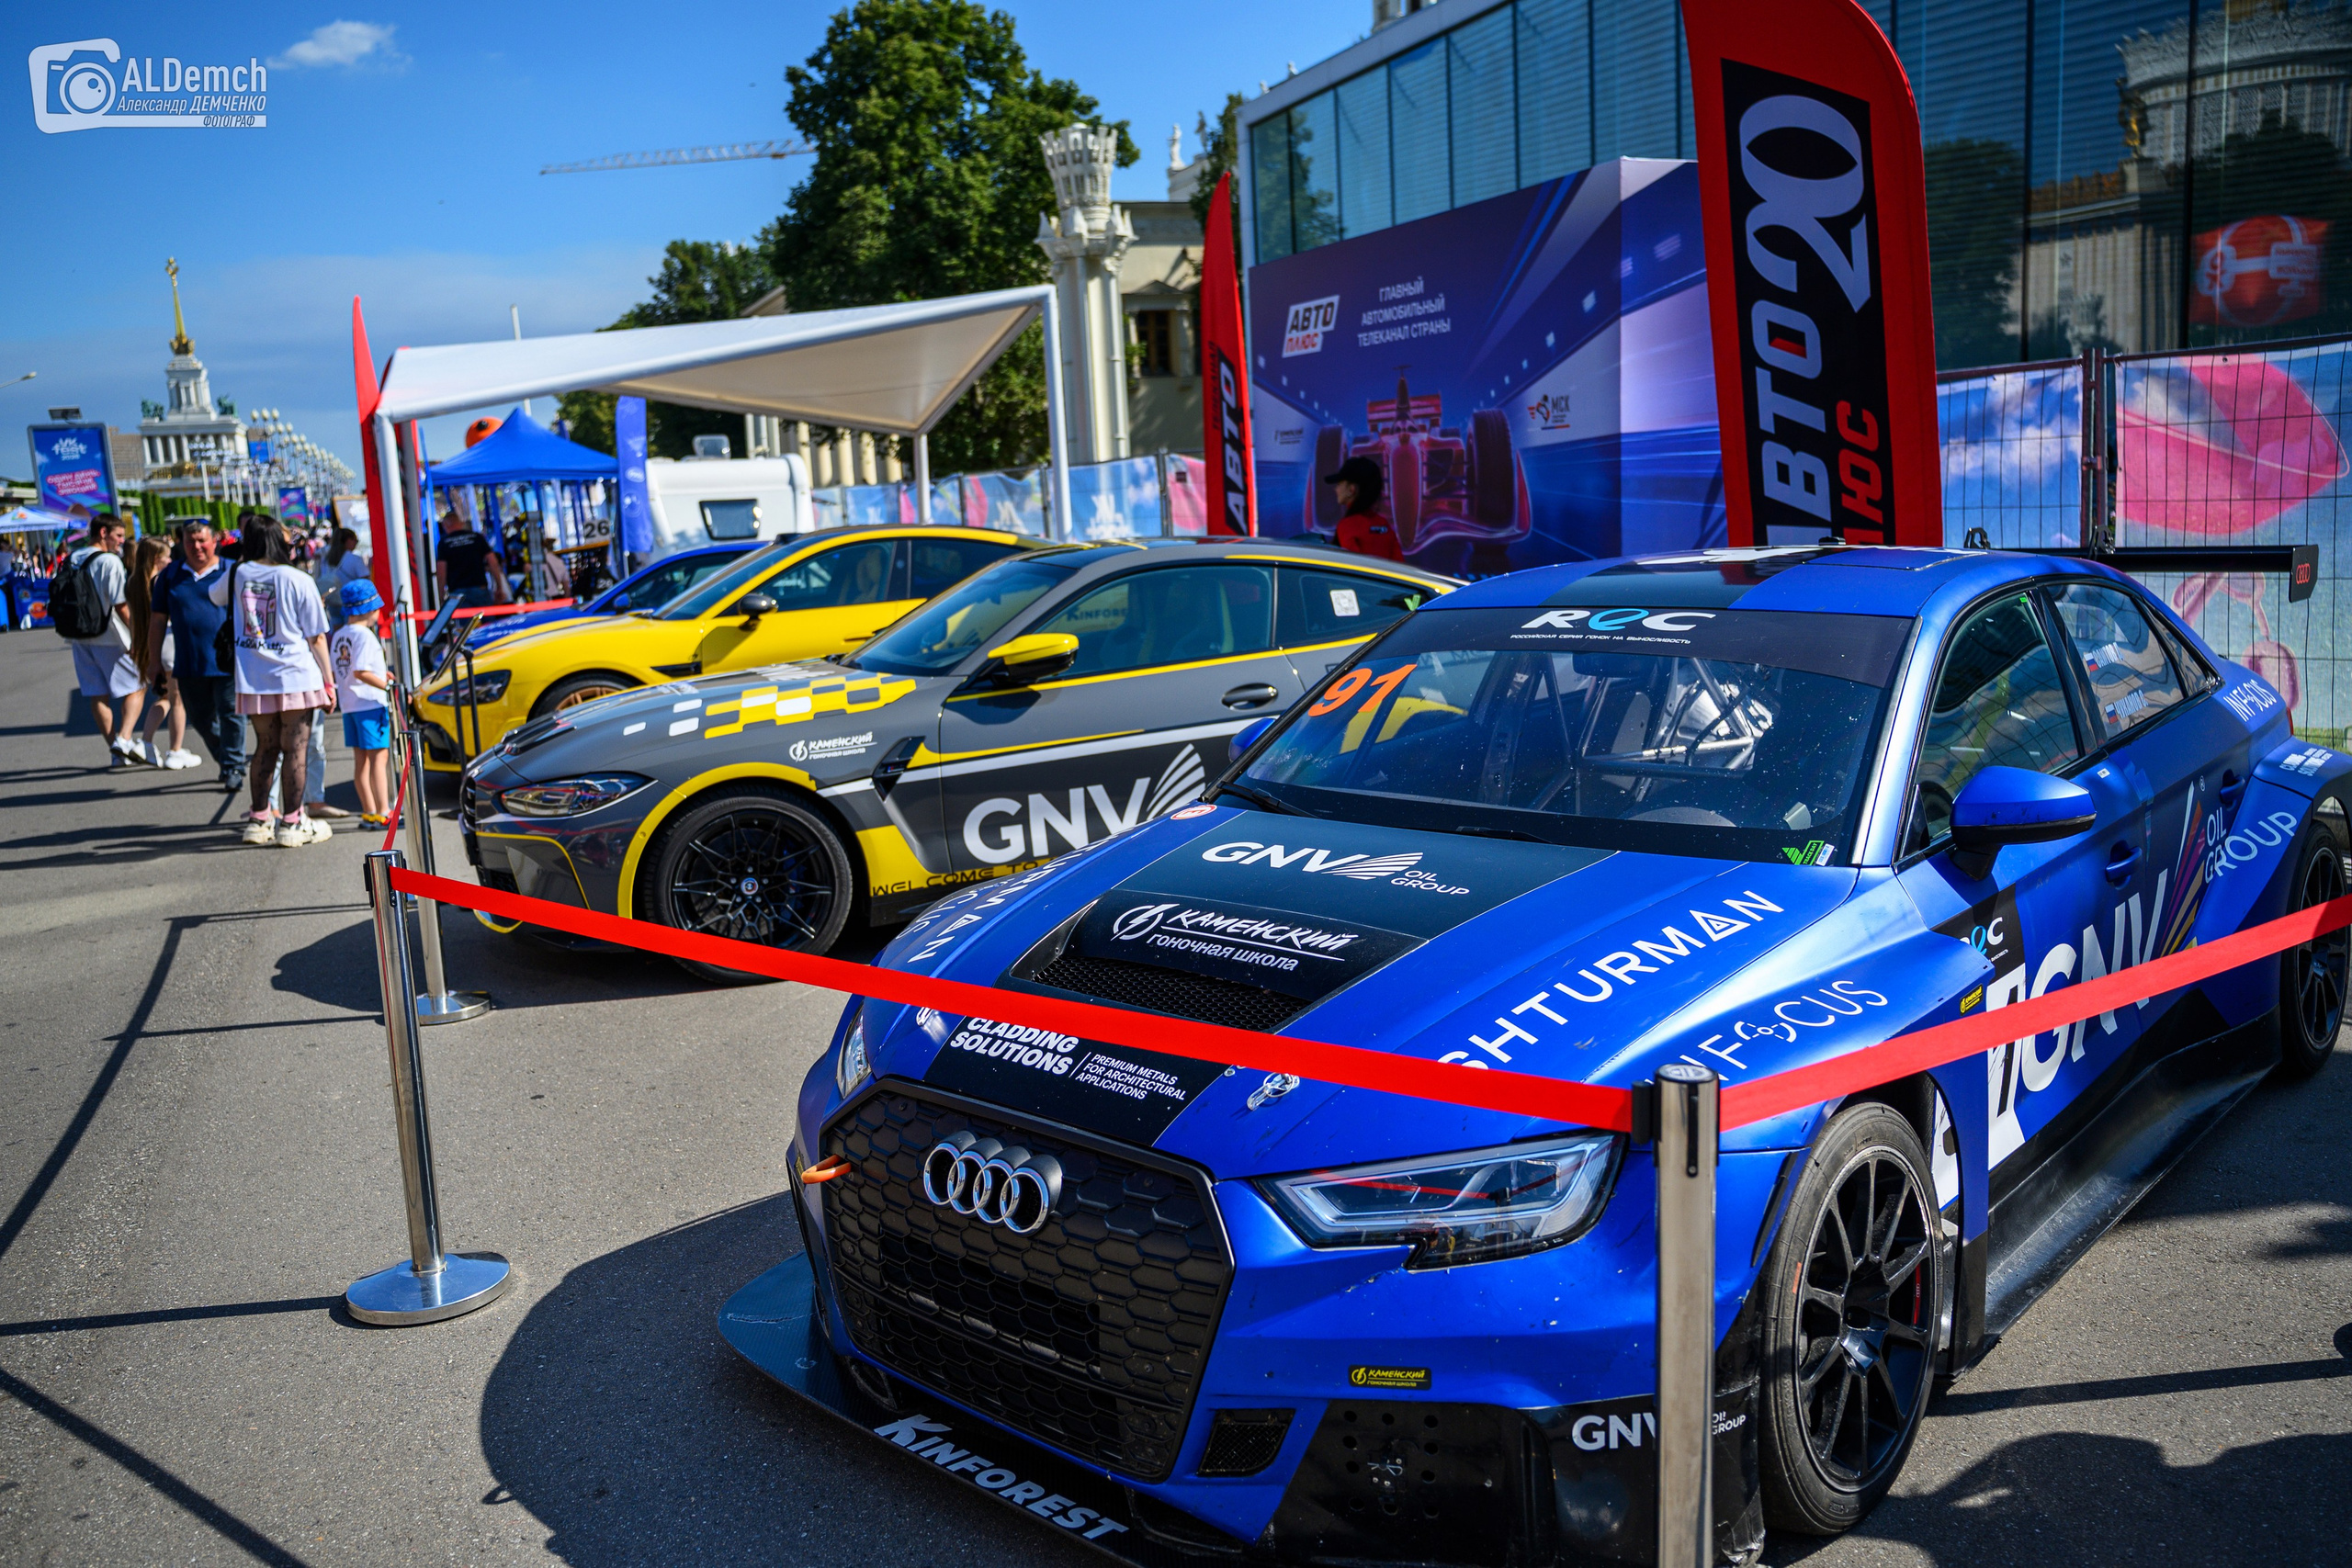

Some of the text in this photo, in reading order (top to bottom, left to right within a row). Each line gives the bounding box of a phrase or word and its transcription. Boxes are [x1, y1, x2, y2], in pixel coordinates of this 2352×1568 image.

[1379, 276, 1424, 301] ГЛАВНЫЙ
[1288, 301, 1335, 334] АВТО
[1361, 293, 1445, 326] АВТОМОБИЛЬНЫЙ
[1285, 333, 1319, 353] ПЛЮС
[1357, 318, 1452, 347] ТЕЛЕКАНАЛ СТРАНЫ
[1220, 361, 1249, 536] АВТО
[584, 520, 609, 538] 26
[1626, 636, 1691, 644] ВЫНОСЛИВОСТЬ
[1307, 664, 1418, 716] 91
[808, 731, 873, 750] КАМЕНСКИЙ
[963, 777, 1151, 864] GNV
[2207, 807, 2227, 847] OIL
[1202, 841, 1371, 874] GNV
[2205, 811, 2298, 884] GROUP
[1390, 877, 1470, 897] GROUP
[1404, 870, 1437, 882] OIL
[1167, 908, 1359, 952] КАМЕНСКИЙ
[2021, 868, 2168, 1092] GNV
[967, 1017, 1079, 1053] CLADDING
[950, 1032, 1074, 1076] SOLUTIONS
[1091, 1054, 1179, 1086] PREMIUM METALS
[1075, 1072, 1148, 1100] APPLICATIONS
[1082, 1062, 1187, 1100] FOR ARCHITECTURAL
[1367, 1370, 1426, 1379] КАМЕНСКИЙ
[873, 1414, 1130, 1540] KINFOREST
